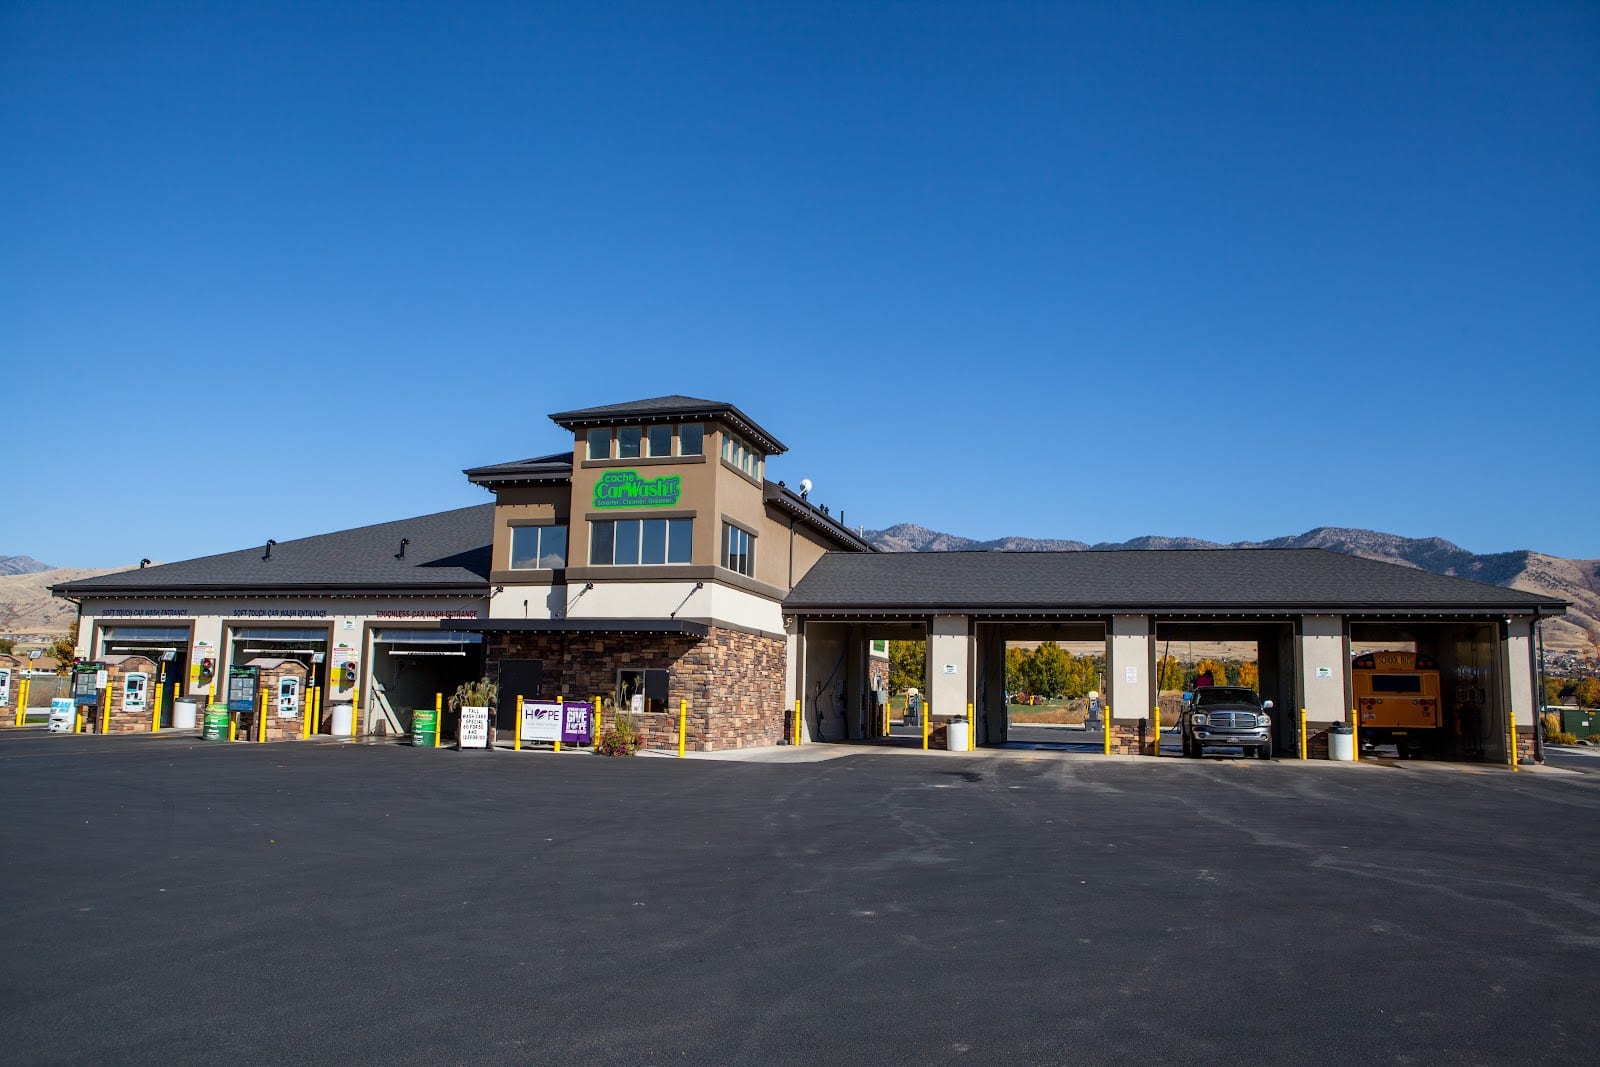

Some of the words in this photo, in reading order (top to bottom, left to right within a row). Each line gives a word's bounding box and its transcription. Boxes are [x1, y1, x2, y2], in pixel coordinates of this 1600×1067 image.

[376, 610, 410, 618] TOUCHLESS
[412, 610, 425, 618] CAR
[426, 610, 444, 618] WASH
[445, 610, 478, 618] ENTRANCE
[1378, 655, 1400, 665] SCHOOL
[1401, 655, 1413, 665] BUS
[567, 711, 588, 723] GIVE
